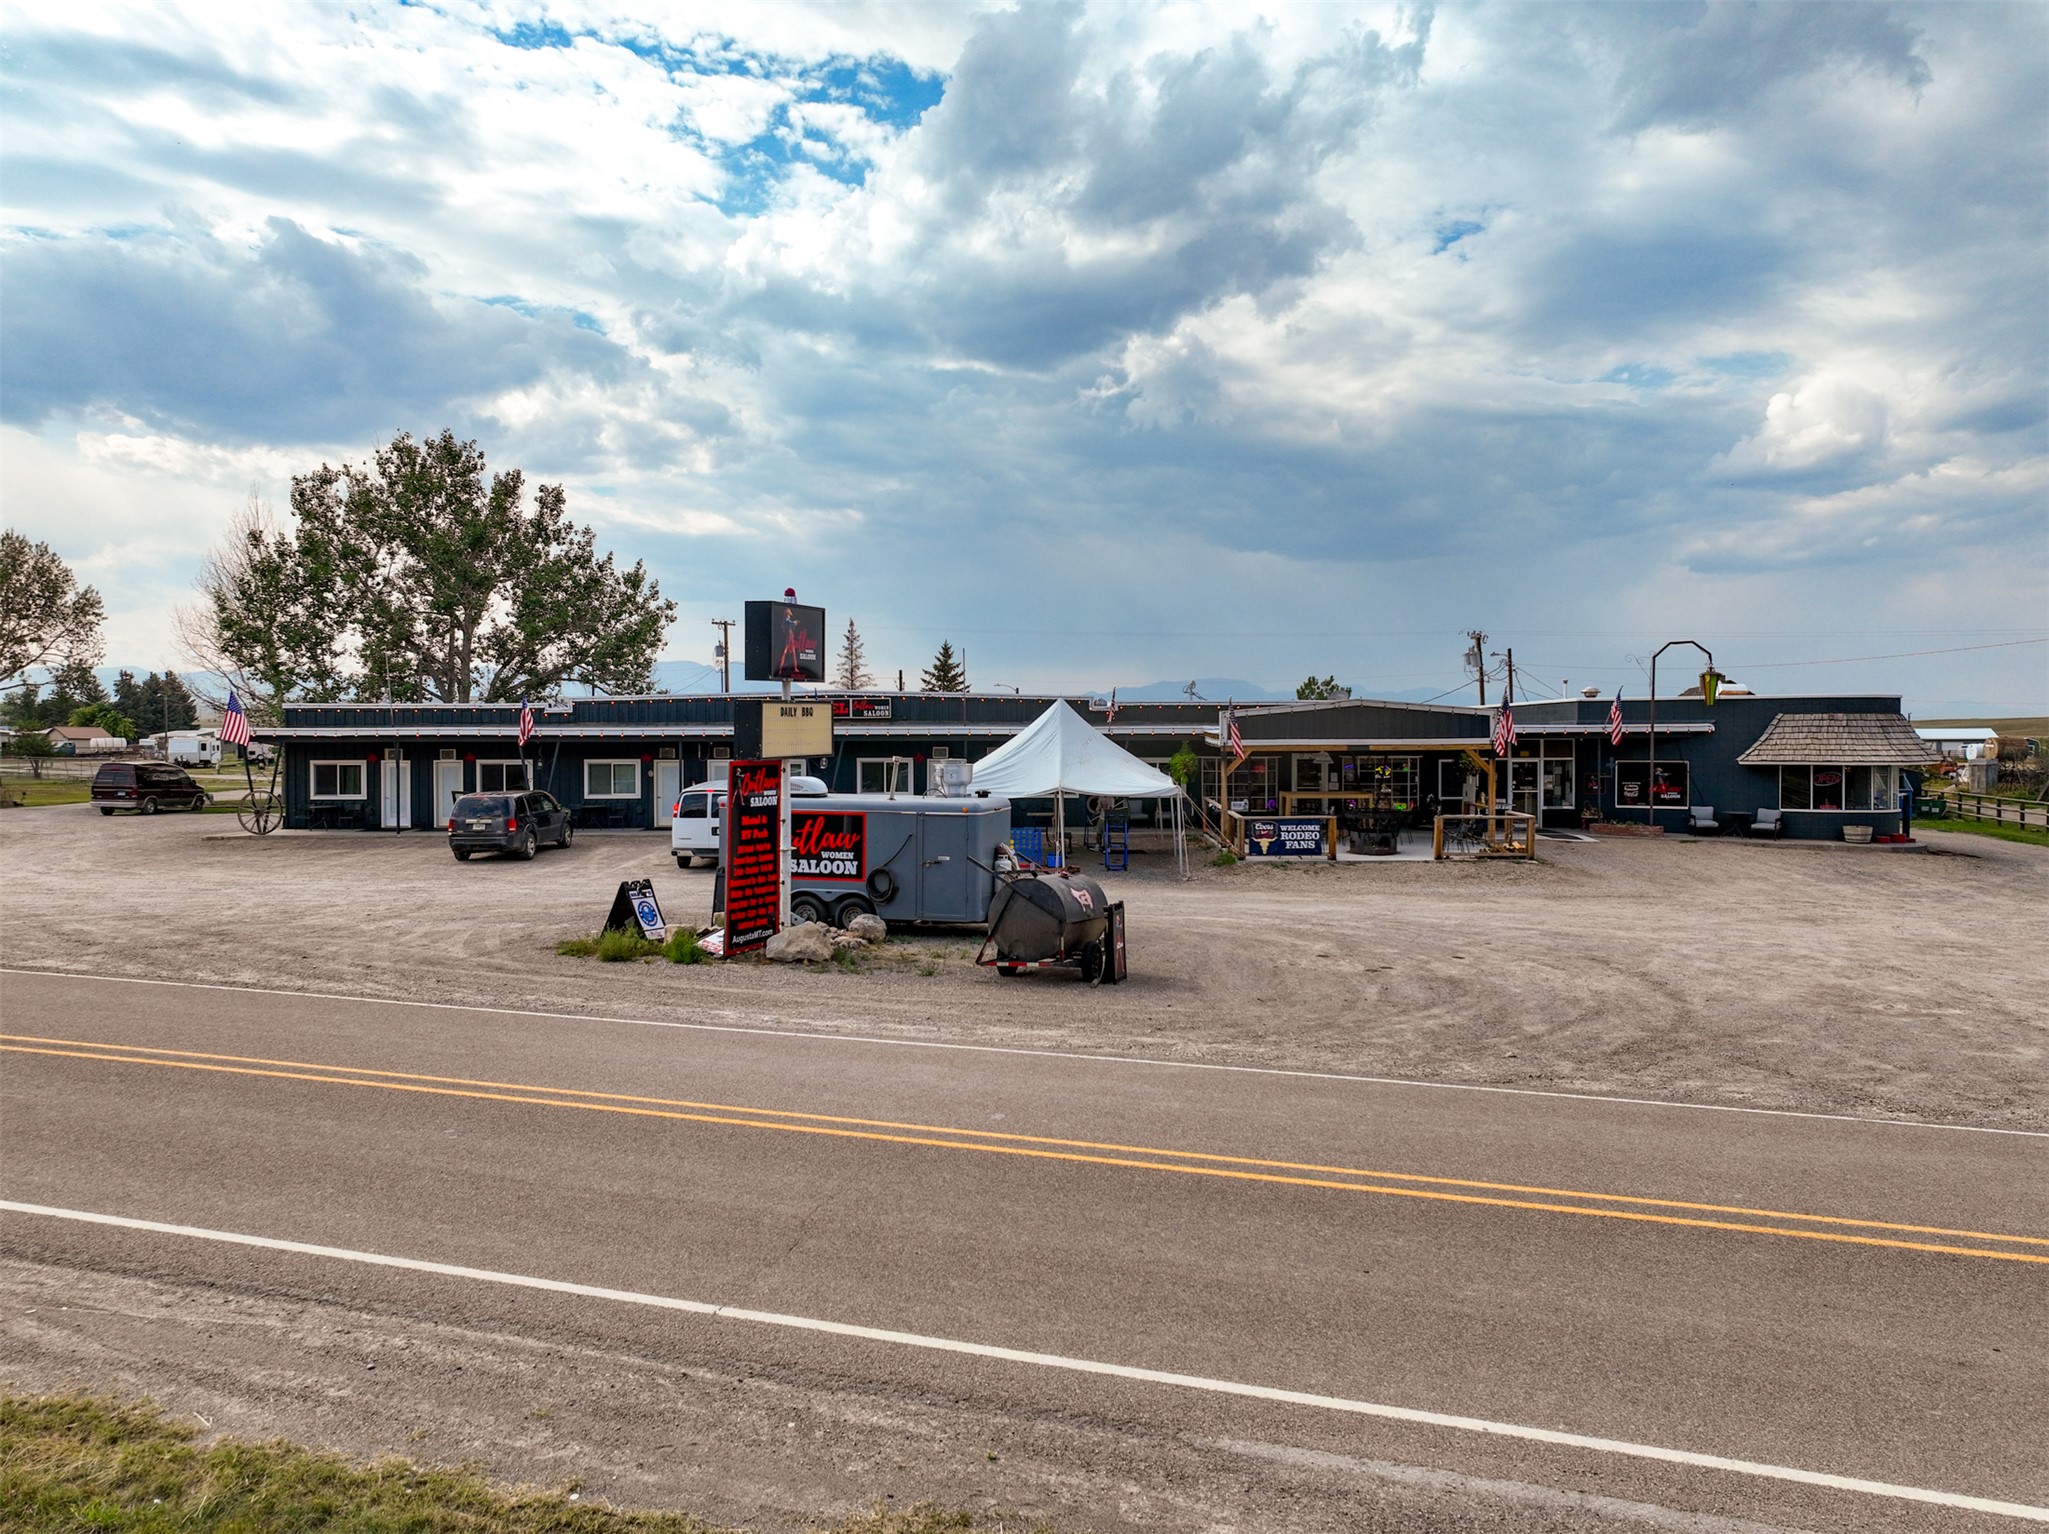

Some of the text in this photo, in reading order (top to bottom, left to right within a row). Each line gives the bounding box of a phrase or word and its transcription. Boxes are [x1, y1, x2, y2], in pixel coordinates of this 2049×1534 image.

[780, 706, 814, 717] DAILY BBQ
[742, 767, 780, 796] Outlaw
[1814, 773, 1841, 784] OPEN
[750, 796, 778, 807] SALOON
[1254, 822, 1274, 830] Coors
[791, 816, 861, 855] utlaw
[1280, 832, 1320, 840] RODEO
[1285, 840, 1316, 849] FANS
[820, 851, 854, 859] WOMEN
[791, 859, 858, 875] SALOON
[732, 929, 774, 944] AugustaMT.com
